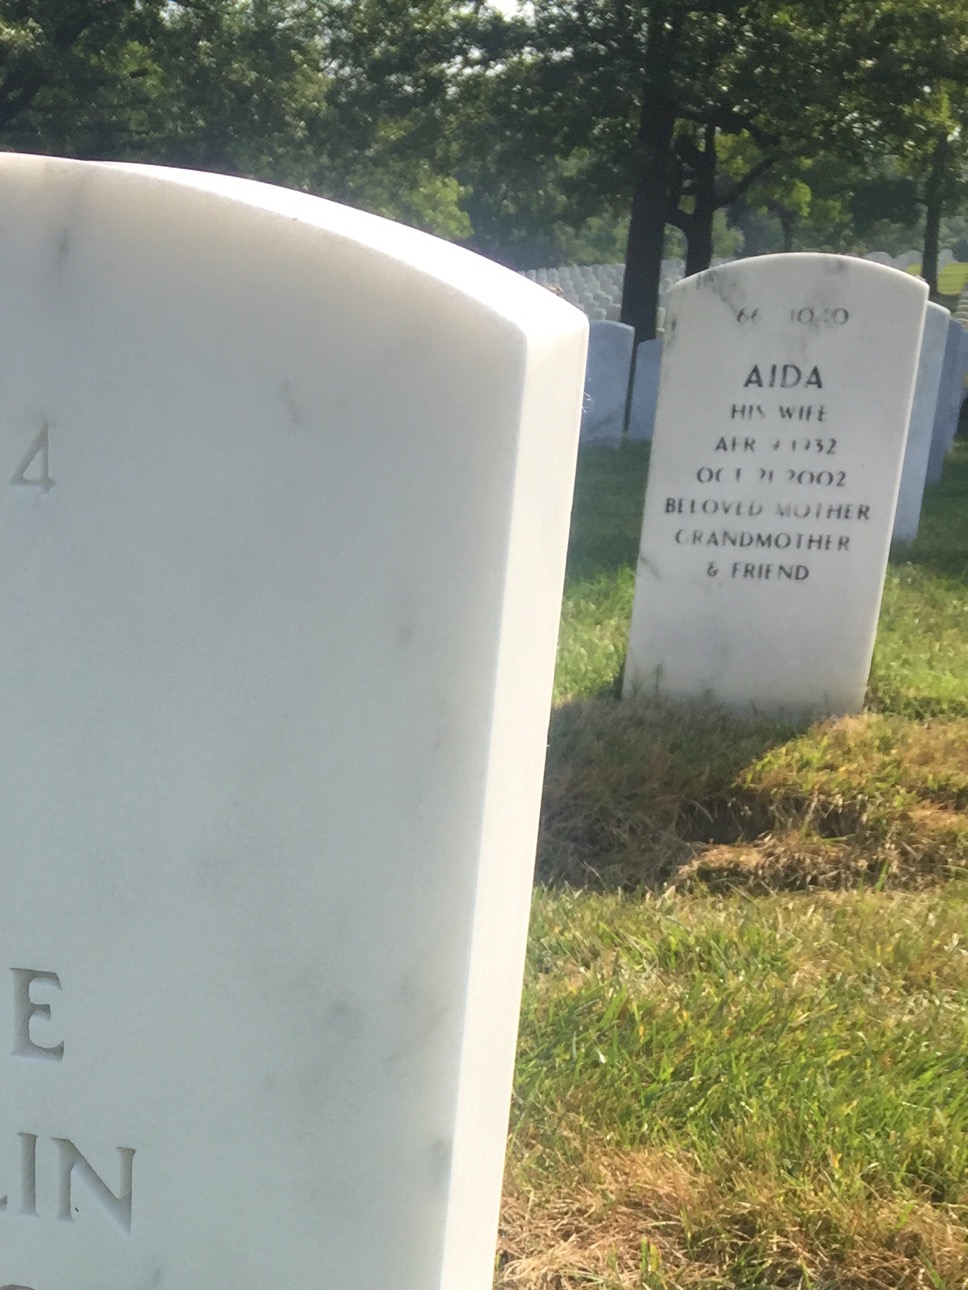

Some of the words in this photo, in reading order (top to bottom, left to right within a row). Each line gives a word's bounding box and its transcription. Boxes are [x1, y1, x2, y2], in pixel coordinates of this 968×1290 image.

[743, 364, 823, 389] AIDA
[731, 403, 765, 420] HIS
[779, 405, 827, 422] WIFE
[787, 469, 846, 487] 2002
[665, 497, 763, 517] BELOVED
[776, 501, 871, 521] MOTHER
[675, 528, 851, 551] GRANDMOTHER
[706, 560, 719, 577] &
[731, 561, 810, 581] FRIEND
